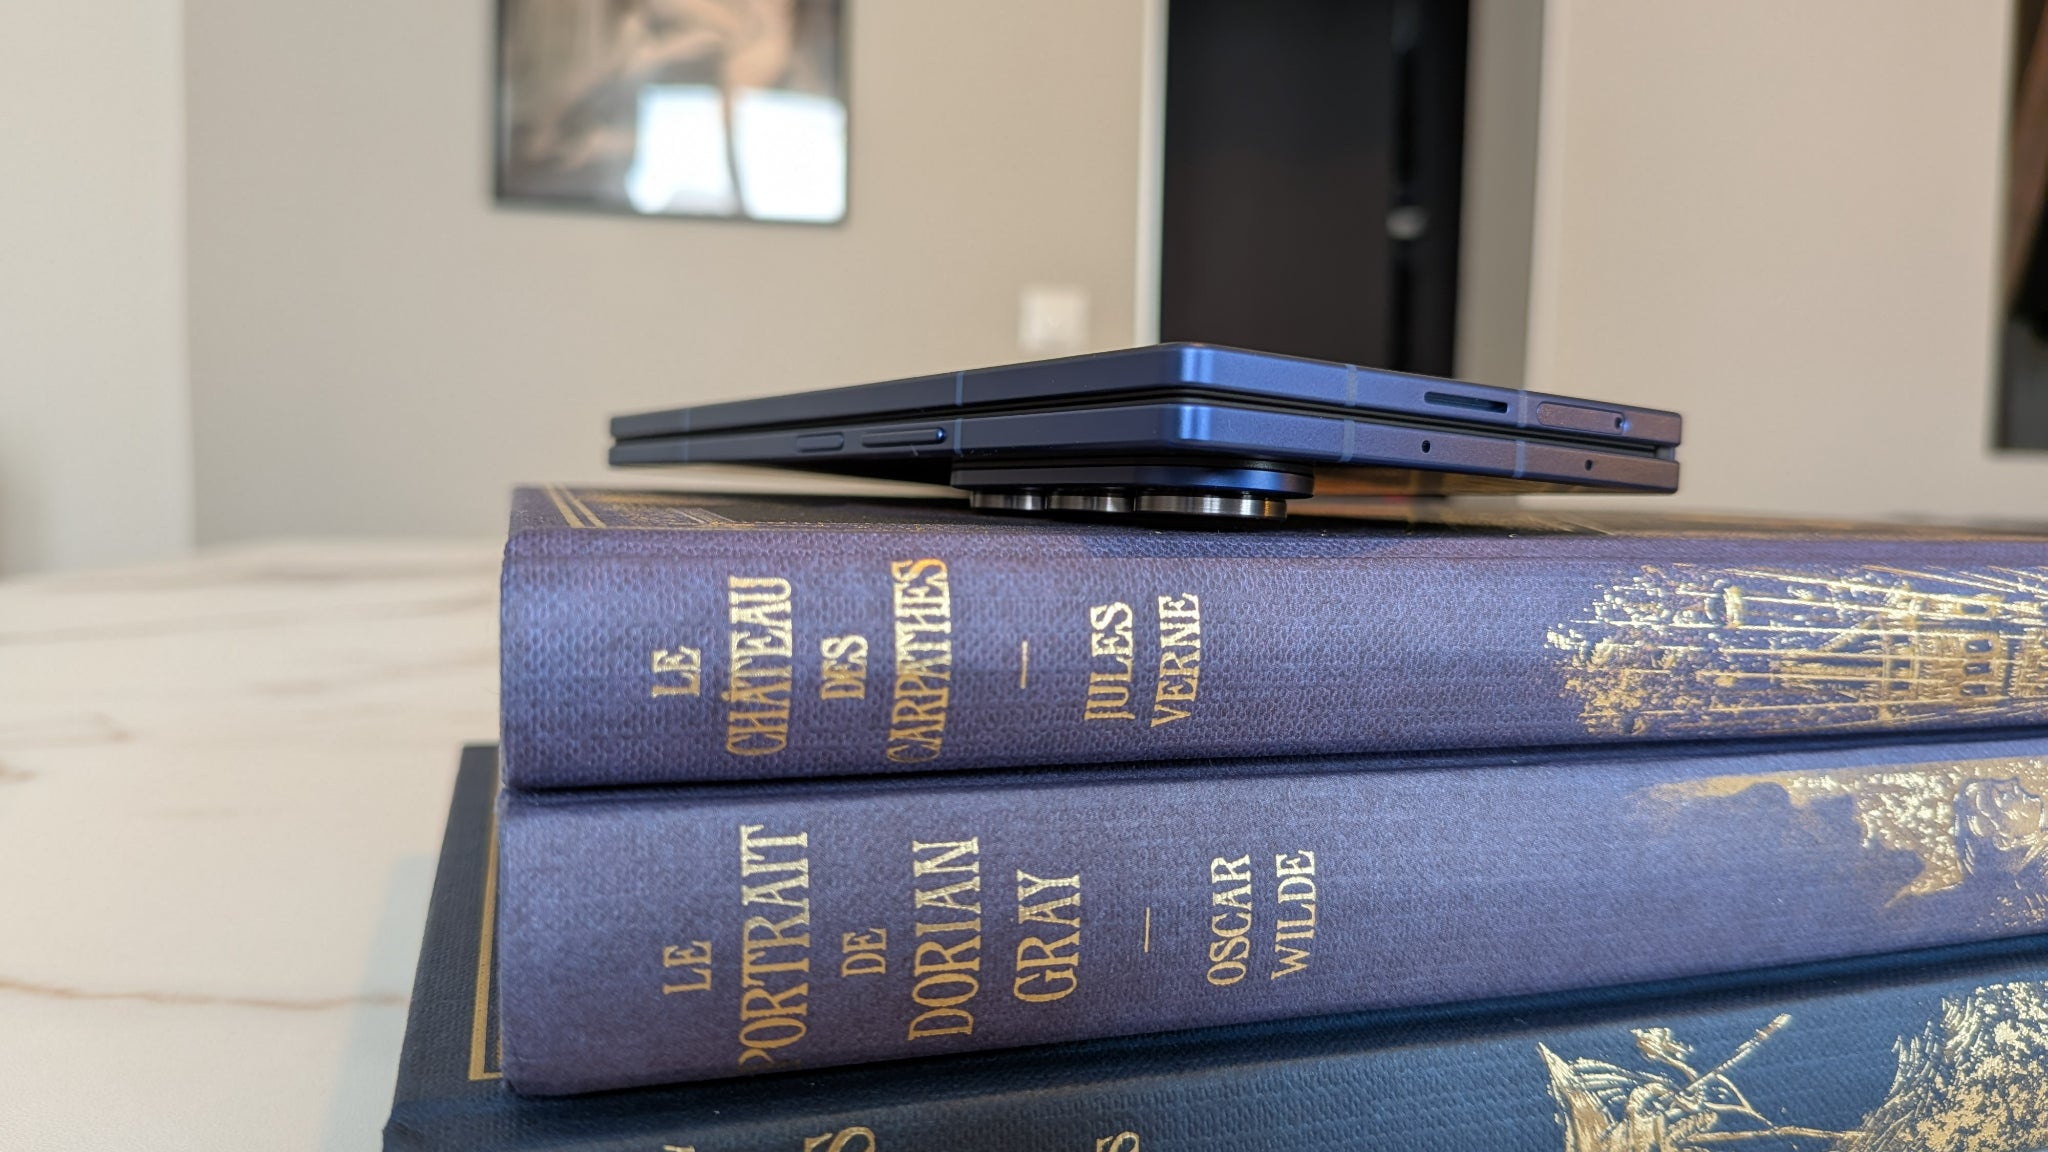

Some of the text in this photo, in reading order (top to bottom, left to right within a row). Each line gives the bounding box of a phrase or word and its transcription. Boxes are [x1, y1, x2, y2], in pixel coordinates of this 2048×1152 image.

[652, 648, 700, 697] LE
[820, 635, 867, 700] DES
[887, 557, 951, 763] CARPATHES
[1083, 602, 1135, 721] JULES
[1151, 593, 1200, 727] VERNE
[662, 941, 712, 994] LE
[841, 928, 887, 978] DE
[907, 837, 982, 1041] DORIAN
[1012, 869, 1081, 1003] GRAY
[1206, 854, 1252, 986] OSCAR
[1271, 849, 1316, 979] WILDE
